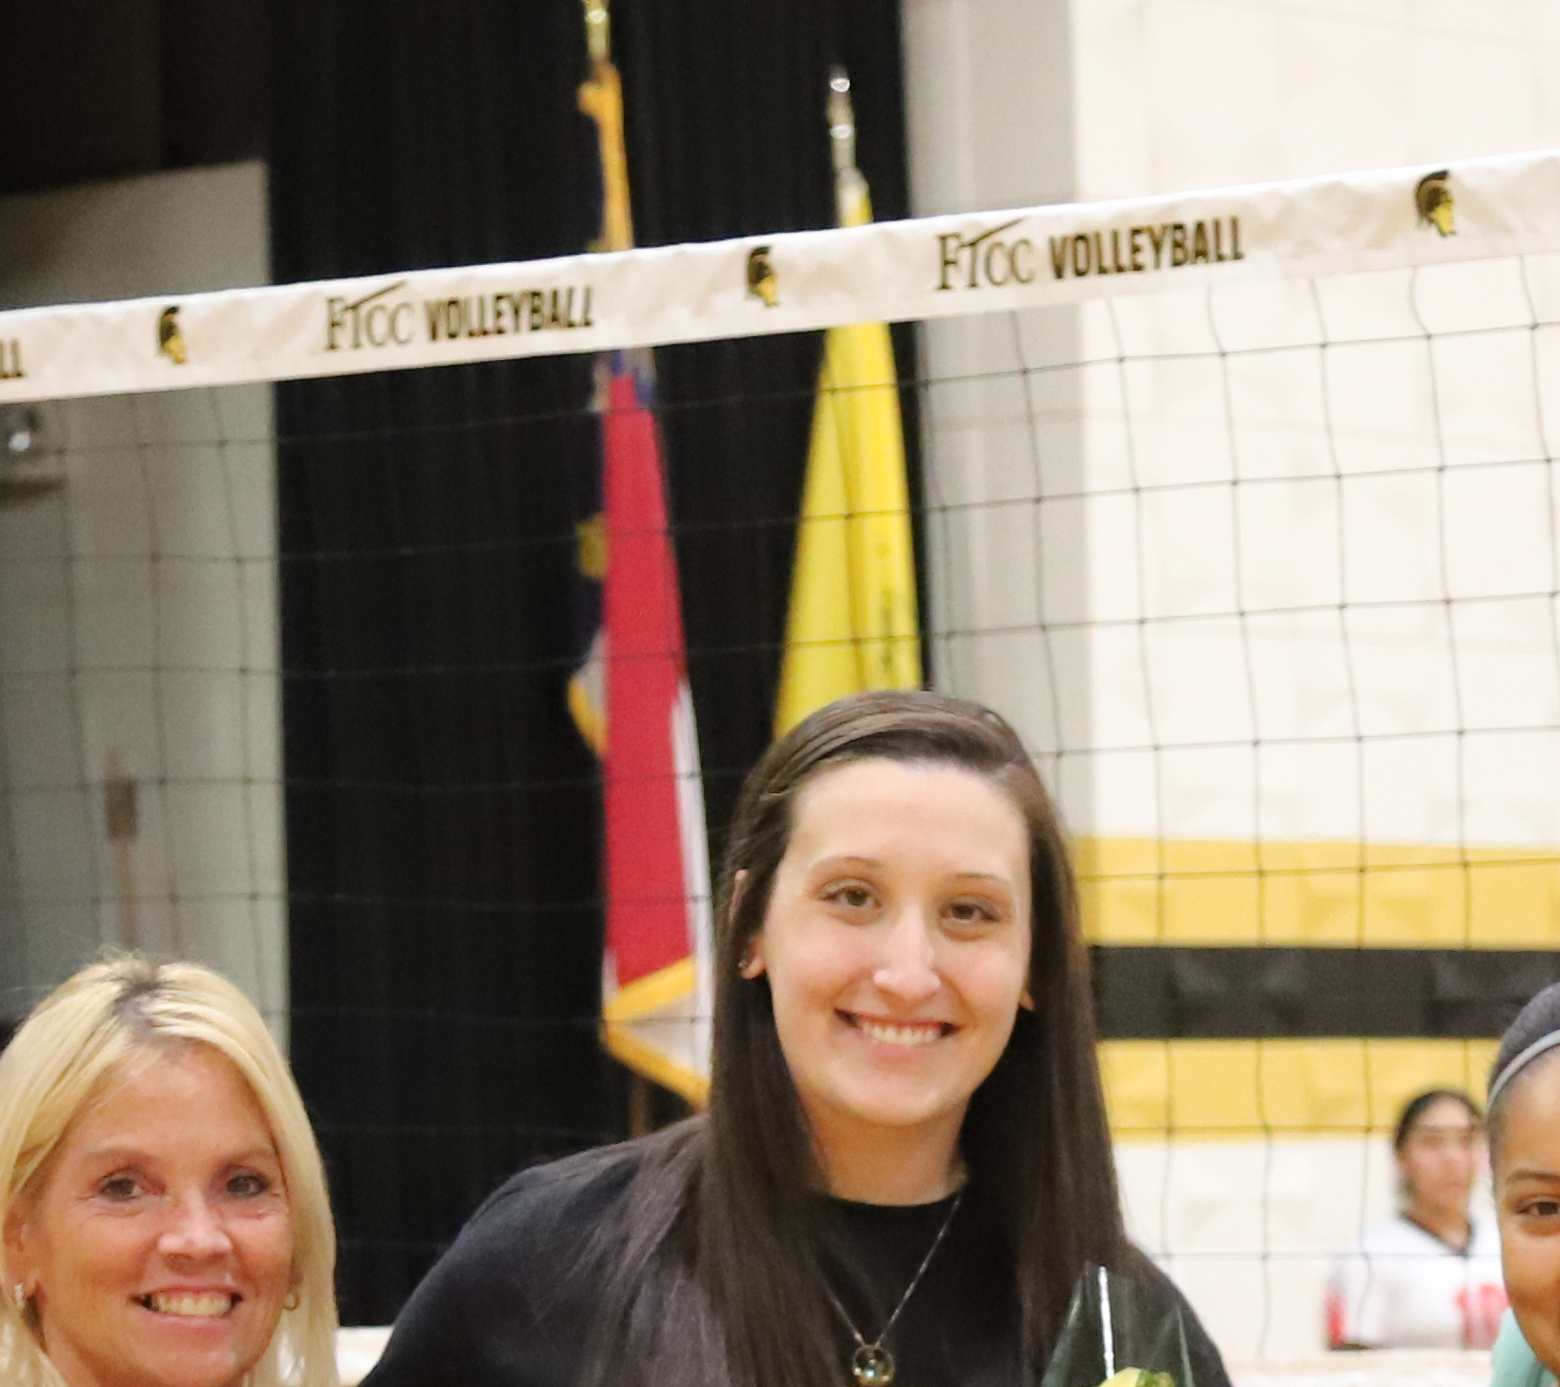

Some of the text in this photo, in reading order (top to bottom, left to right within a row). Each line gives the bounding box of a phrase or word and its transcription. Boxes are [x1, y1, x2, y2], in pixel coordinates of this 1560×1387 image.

[934, 214, 1246, 291] FTCC VOLLEYBALL
[325, 280, 594, 351] FTCC VOLLEYBALL
